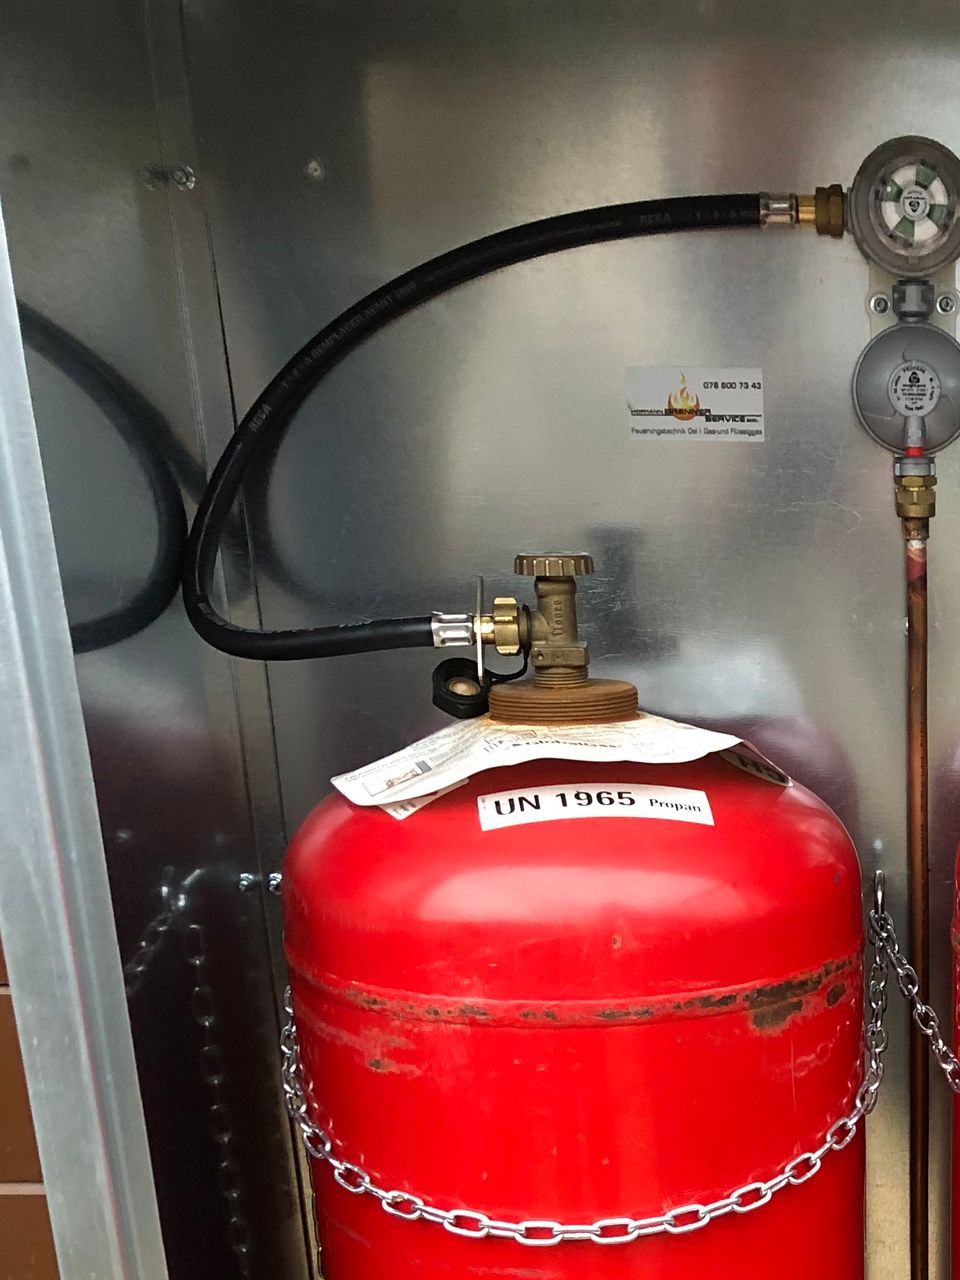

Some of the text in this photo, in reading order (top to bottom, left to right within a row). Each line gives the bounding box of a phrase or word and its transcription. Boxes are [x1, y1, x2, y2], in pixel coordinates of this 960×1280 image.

[705, 414, 745, 423] SERVICE
[494, 790, 702, 816] UN 1965 Propan
